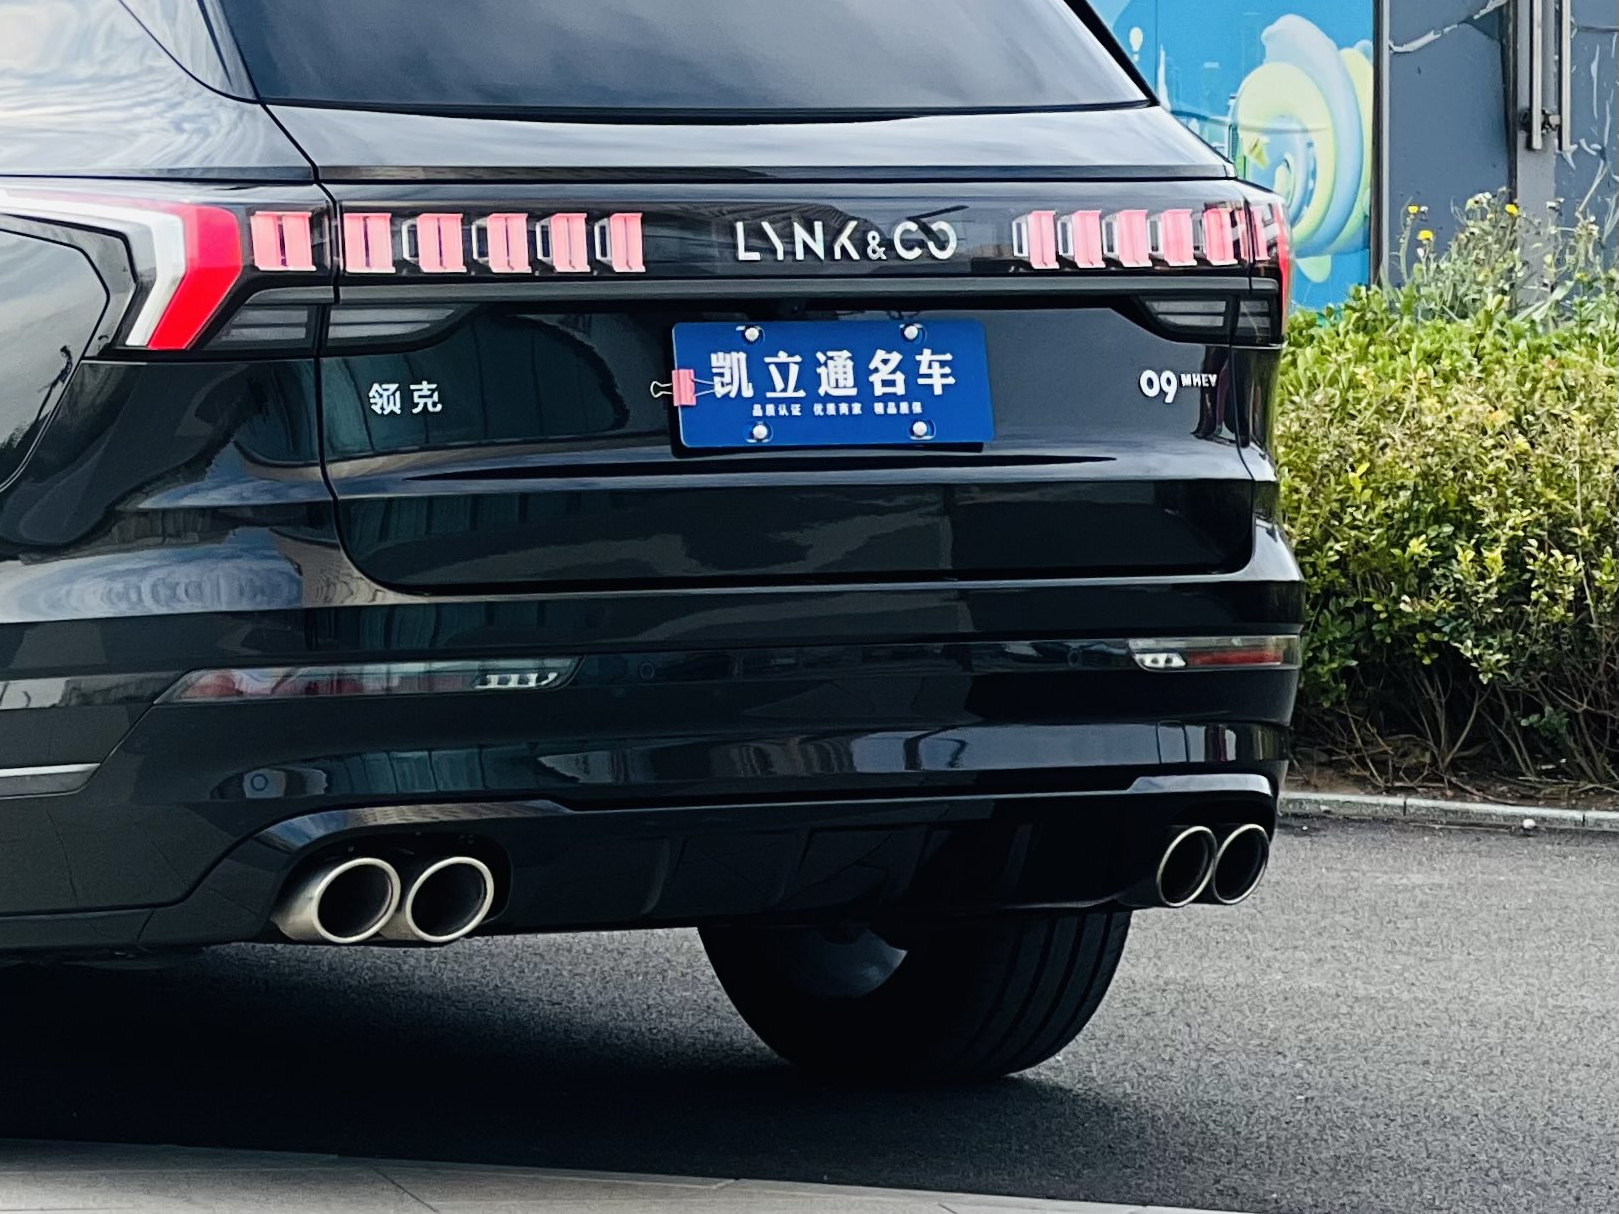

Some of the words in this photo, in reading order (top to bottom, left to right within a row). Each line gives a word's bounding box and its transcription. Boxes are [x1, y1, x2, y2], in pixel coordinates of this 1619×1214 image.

[735, 220, 958, 261] LYNK&CO
[710, 348, 956, 399] 凯立通名车
[1139, 369, 1178, 404] 09
[368, 380, 442, 415] 领克
